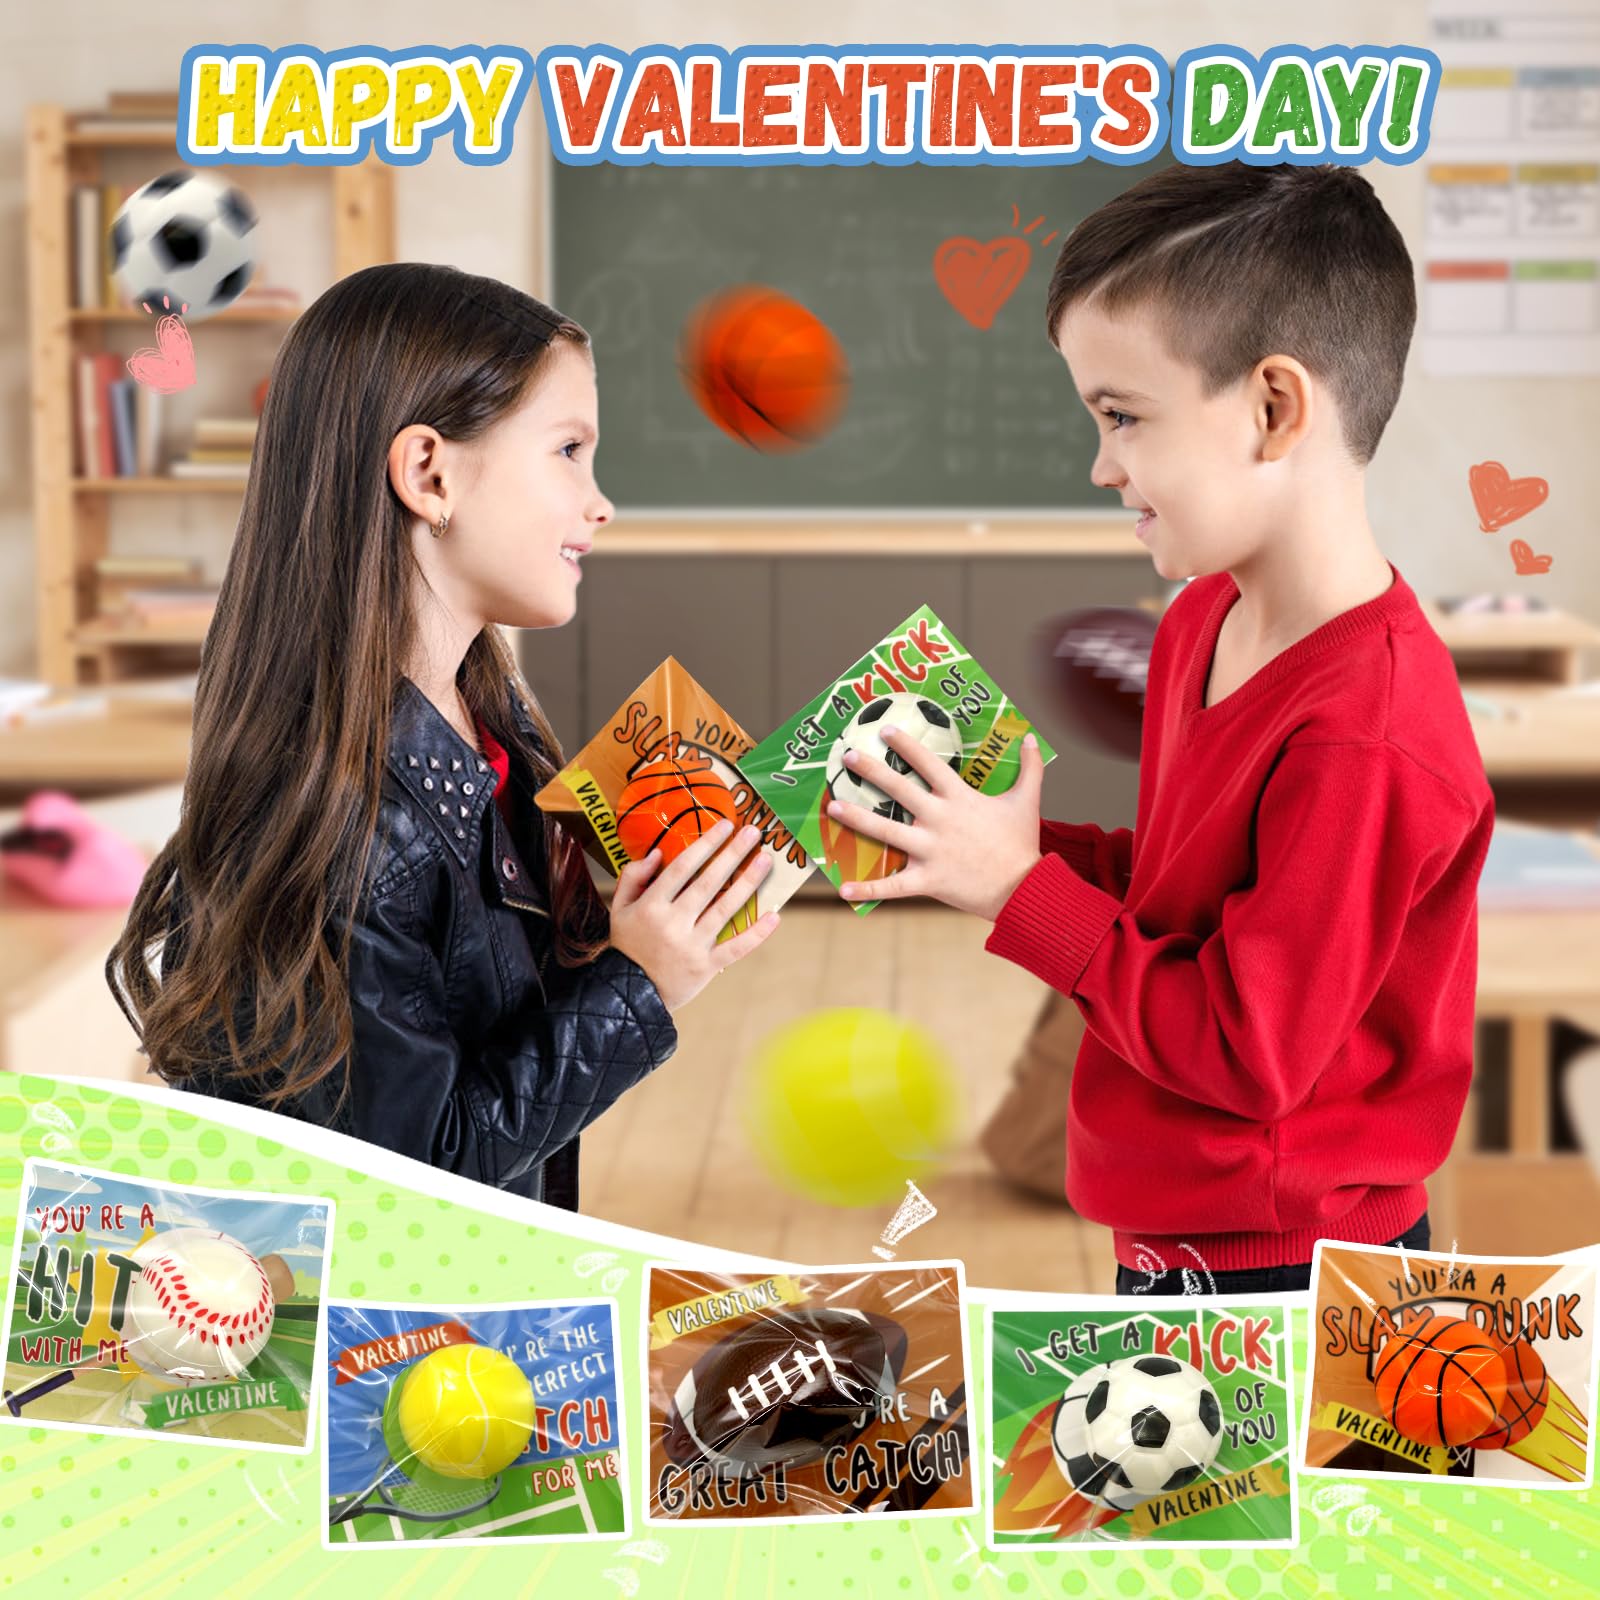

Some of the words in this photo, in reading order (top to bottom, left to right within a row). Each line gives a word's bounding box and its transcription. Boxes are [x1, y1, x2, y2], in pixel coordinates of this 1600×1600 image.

[785, 714, 829, 761] GET
[831, 693, 853, 718] A
[853, 618, 950, 704] KICK
[938, 663, 968, 698] OF
[951, 680, 992, 726] YOU
[963, 729, 1010, 790] ENTINE
[140, 1203, 155, 1230] A
[26, 1244, 143, 1333] HIT
[666, 1279, 782, 1335] VALENTINE
[1490, 1272, 1506, 1296] A
[558, 1322, 600, 1353] THE
[1466, 1293, 1583, 1346] DUNK
[20, 1335, 82, 1364] WITH
[97, 1338, 129, 1364] ME
[350, 1325, 452, 1371] VALENTINE
[1049, 1323, 1101, 1361] GET
[1121, 1320, 1143, 1351] A
[1152, 1315, 1274, 1375] KICK
[528, 1352, 608, 1397] ERFECT
[1234, 1381, 1267, 1414] OF
[165, 1380, 280, 1419] VALENTINE
[929, 1386, 949, 1419] A
[523, 1395, 611, 1455] TCH
[1223, 1412, 1276, 1449] YOU
[1335, 1406, 1432, 1464] VALENTINE
[532, 1464, 576, 1496] FOR
[583, 1454, 618, 1482] ME
[658, 1457, 794, 1515] GREAT
[824, 1429, 963, 1496] CATCH
[1147, 1469, 1262, 1526] VALENTINE
